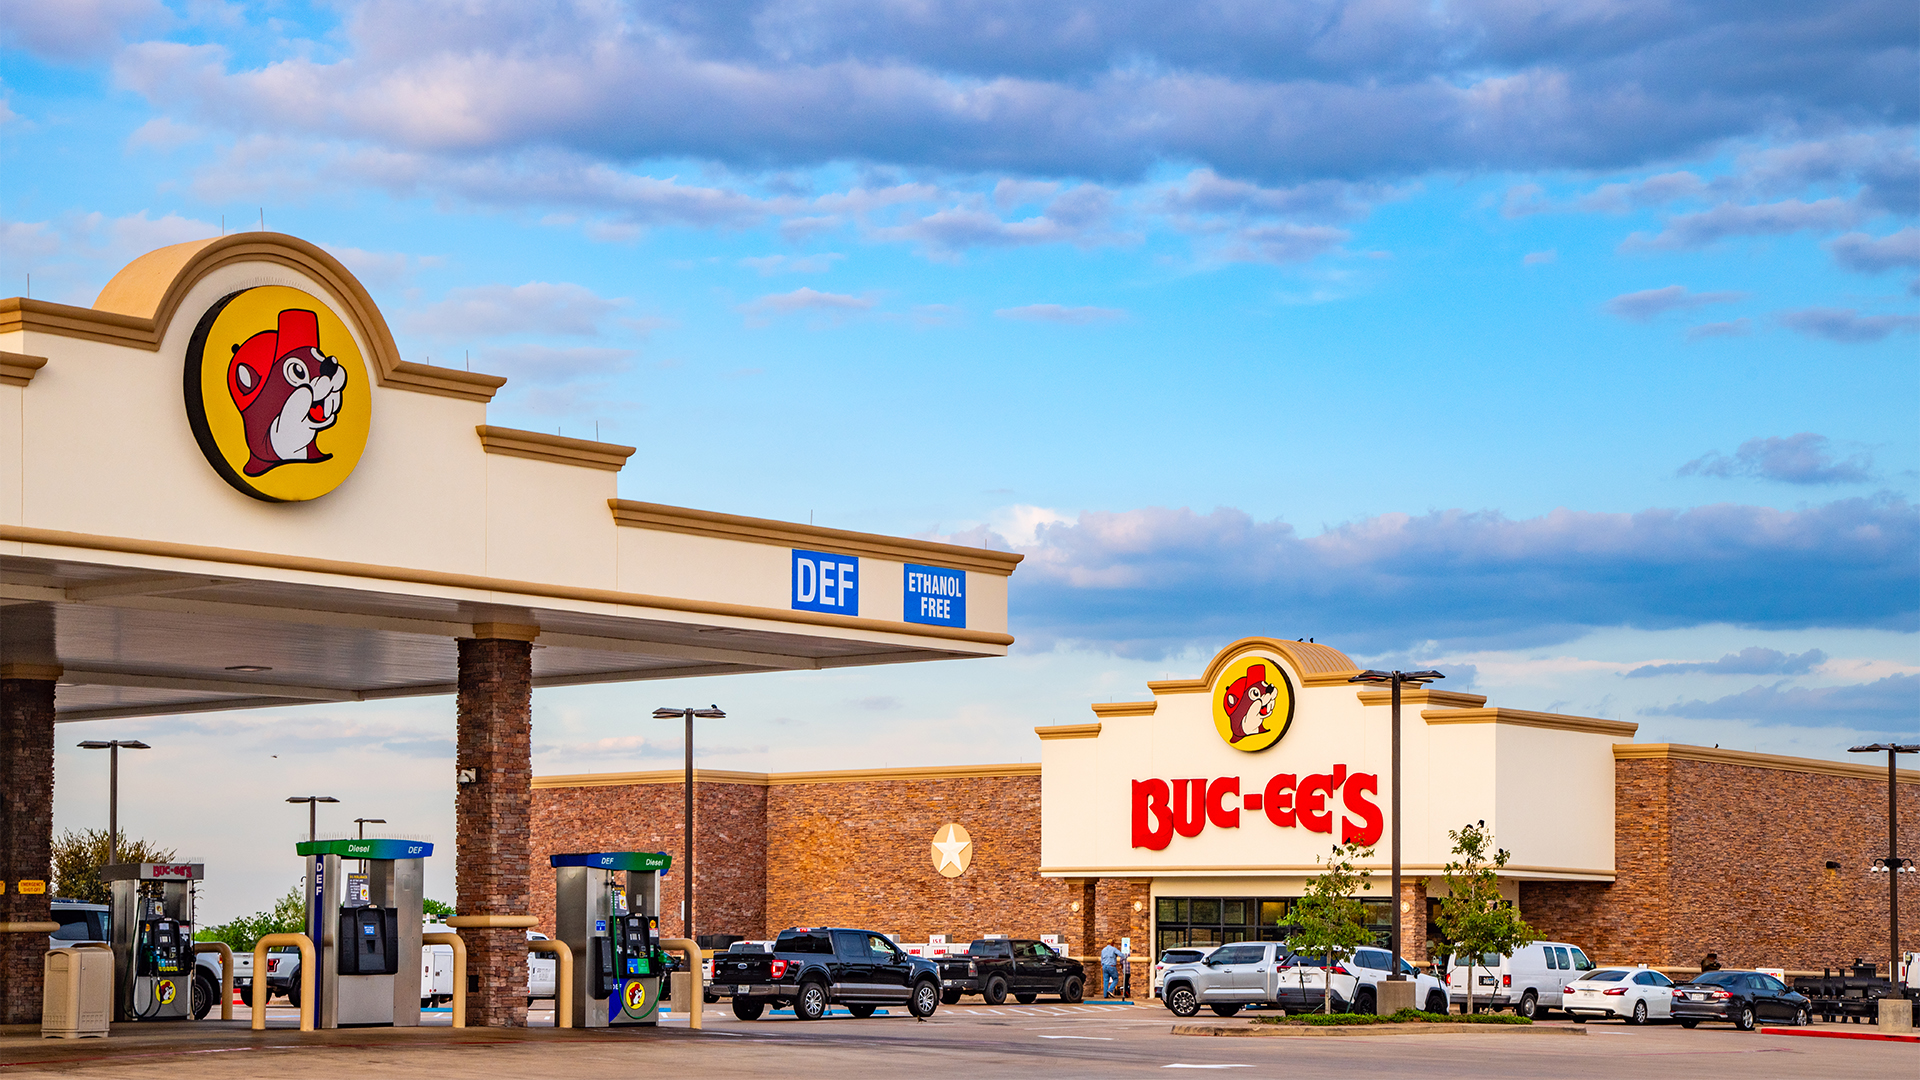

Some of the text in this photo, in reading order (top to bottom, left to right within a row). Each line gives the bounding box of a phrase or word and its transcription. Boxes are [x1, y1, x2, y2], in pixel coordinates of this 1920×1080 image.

[797, 557, 854, 607] DEF
[908, 572, 962, 598] ETHANOL
[920, 596, 951, 619] FREE
[1131, 763, 1384, 851] BUC-EE'S
[348, 844, 423, 854] Diesel DEF
[153, 865, 192, 878] BUC-EE'S
[601, 857, 664, 866] DEF Diesel
